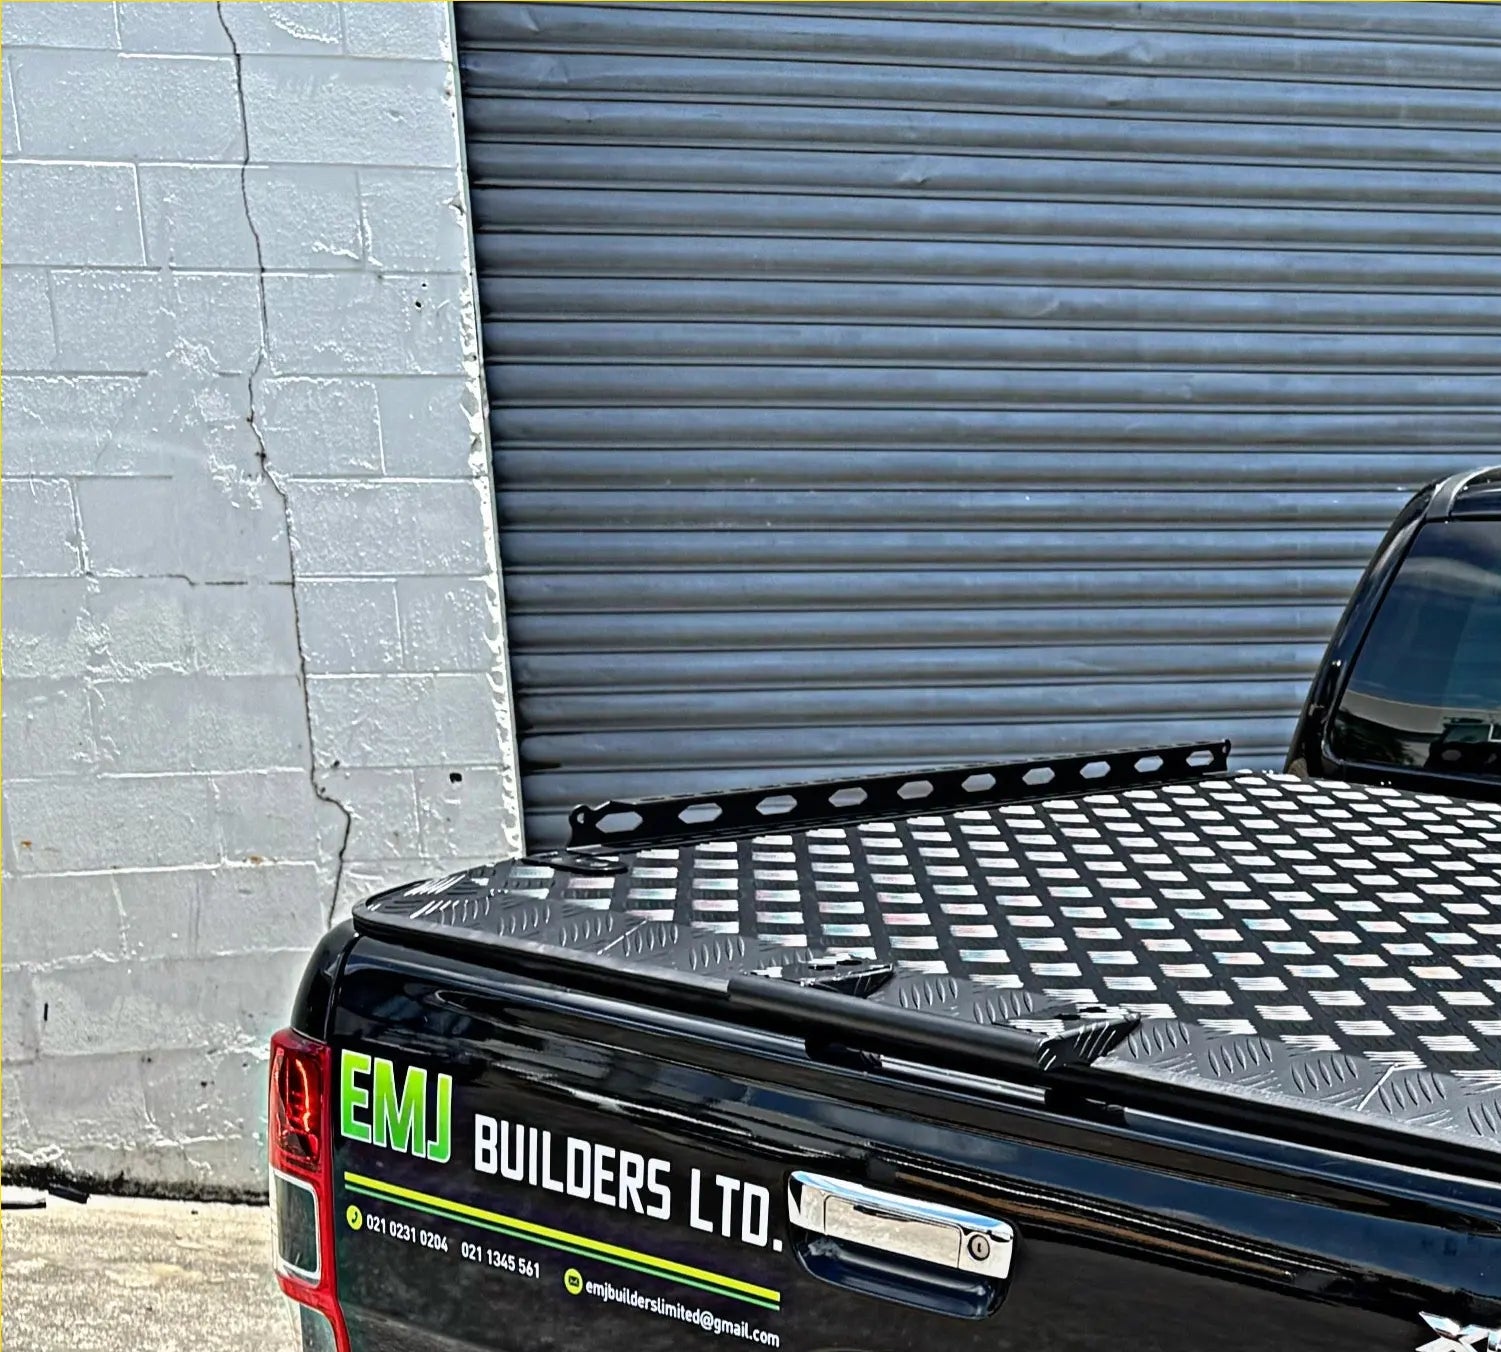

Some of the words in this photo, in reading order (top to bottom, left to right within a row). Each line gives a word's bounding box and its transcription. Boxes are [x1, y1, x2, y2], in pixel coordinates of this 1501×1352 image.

[340, 1048, 453, 1164] EMJ
[474, 1113, 671, 1221] BUILDERS
[689, 1167, 783, 1253] LTD.
[366, 1213, 386, 1234] 021
[389, 1220, 416, 1243] 0231
[419, 1229, 448, 1252] 0204
[461, 1241, 482, 1262] 021
[486, 1248, 516, 1272] 1345
[518, 1256, 540, 1279] 561
[585, 1280, 780, 1348] emjbuilderslimited@gmail.com
